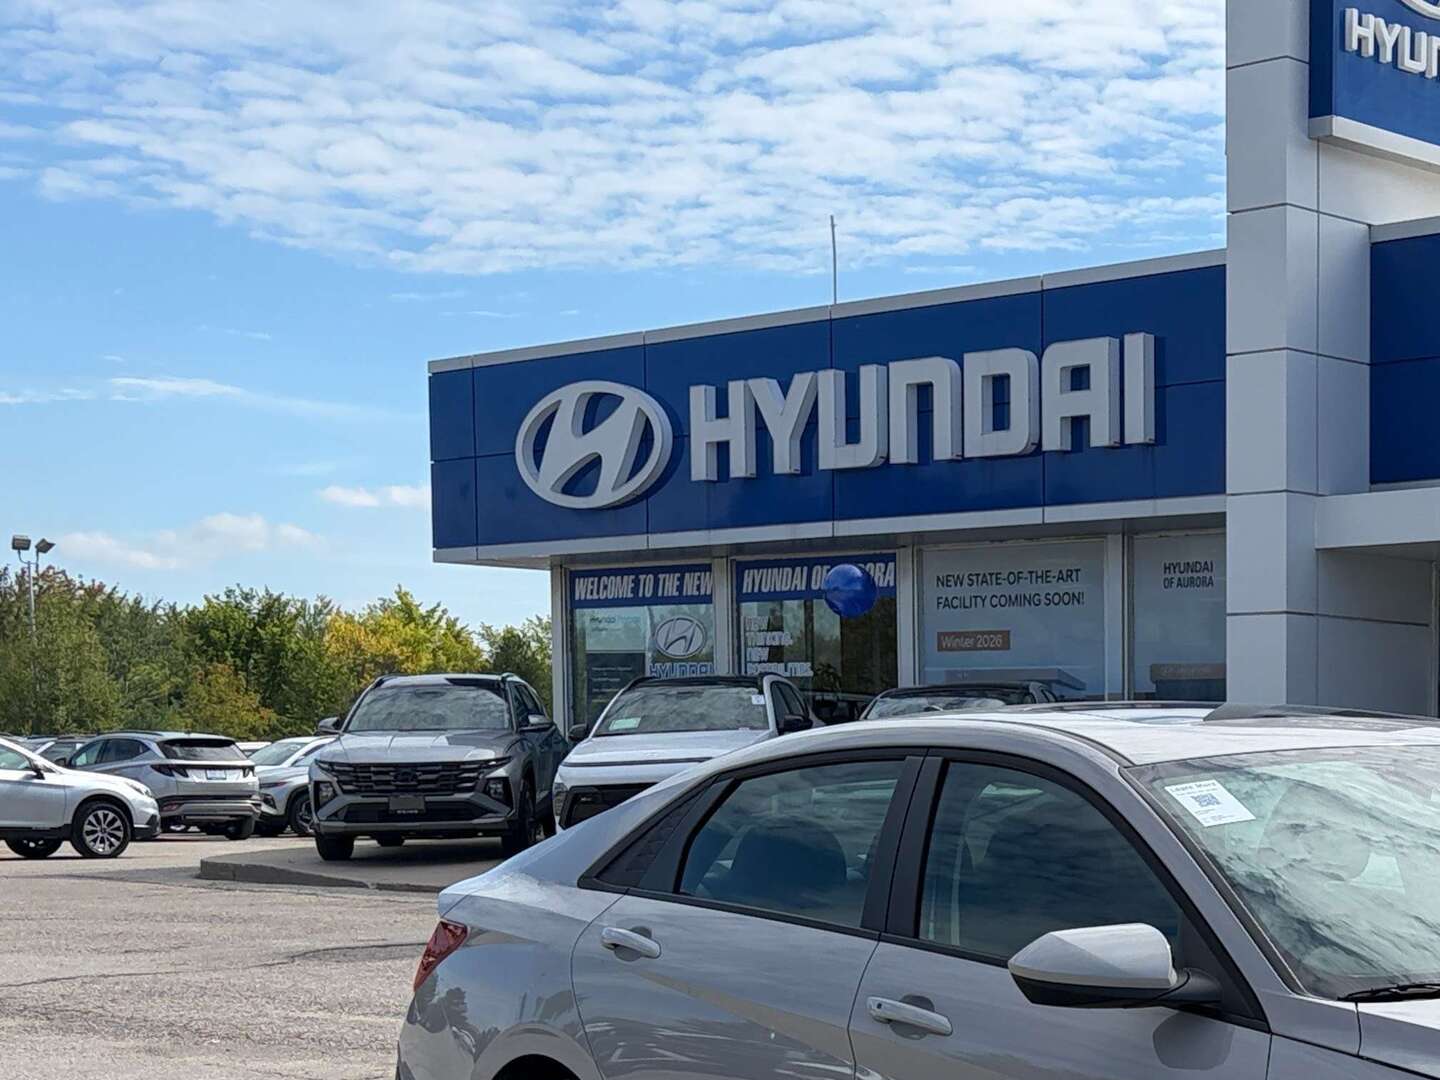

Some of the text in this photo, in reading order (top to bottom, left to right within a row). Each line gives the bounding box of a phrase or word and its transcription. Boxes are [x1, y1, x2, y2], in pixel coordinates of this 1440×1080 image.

[689, 332, 1155, 481] HYUNDAI
[1163, 560, 1214, 574] HYUNDAI
[575, 571, 713, 601] WELCOME TO THE NEW
[743, 565, 808, 594] HYUNDAI
[936, 568, 1081, 588] NEW STATE-OF-THE-ART
[1163, 575, 1214, 589] OF AURORA
[936, 591, 1085, 610] FACILITY COMING SOON!
[941, 633, 1003, 649] Winter 2026
